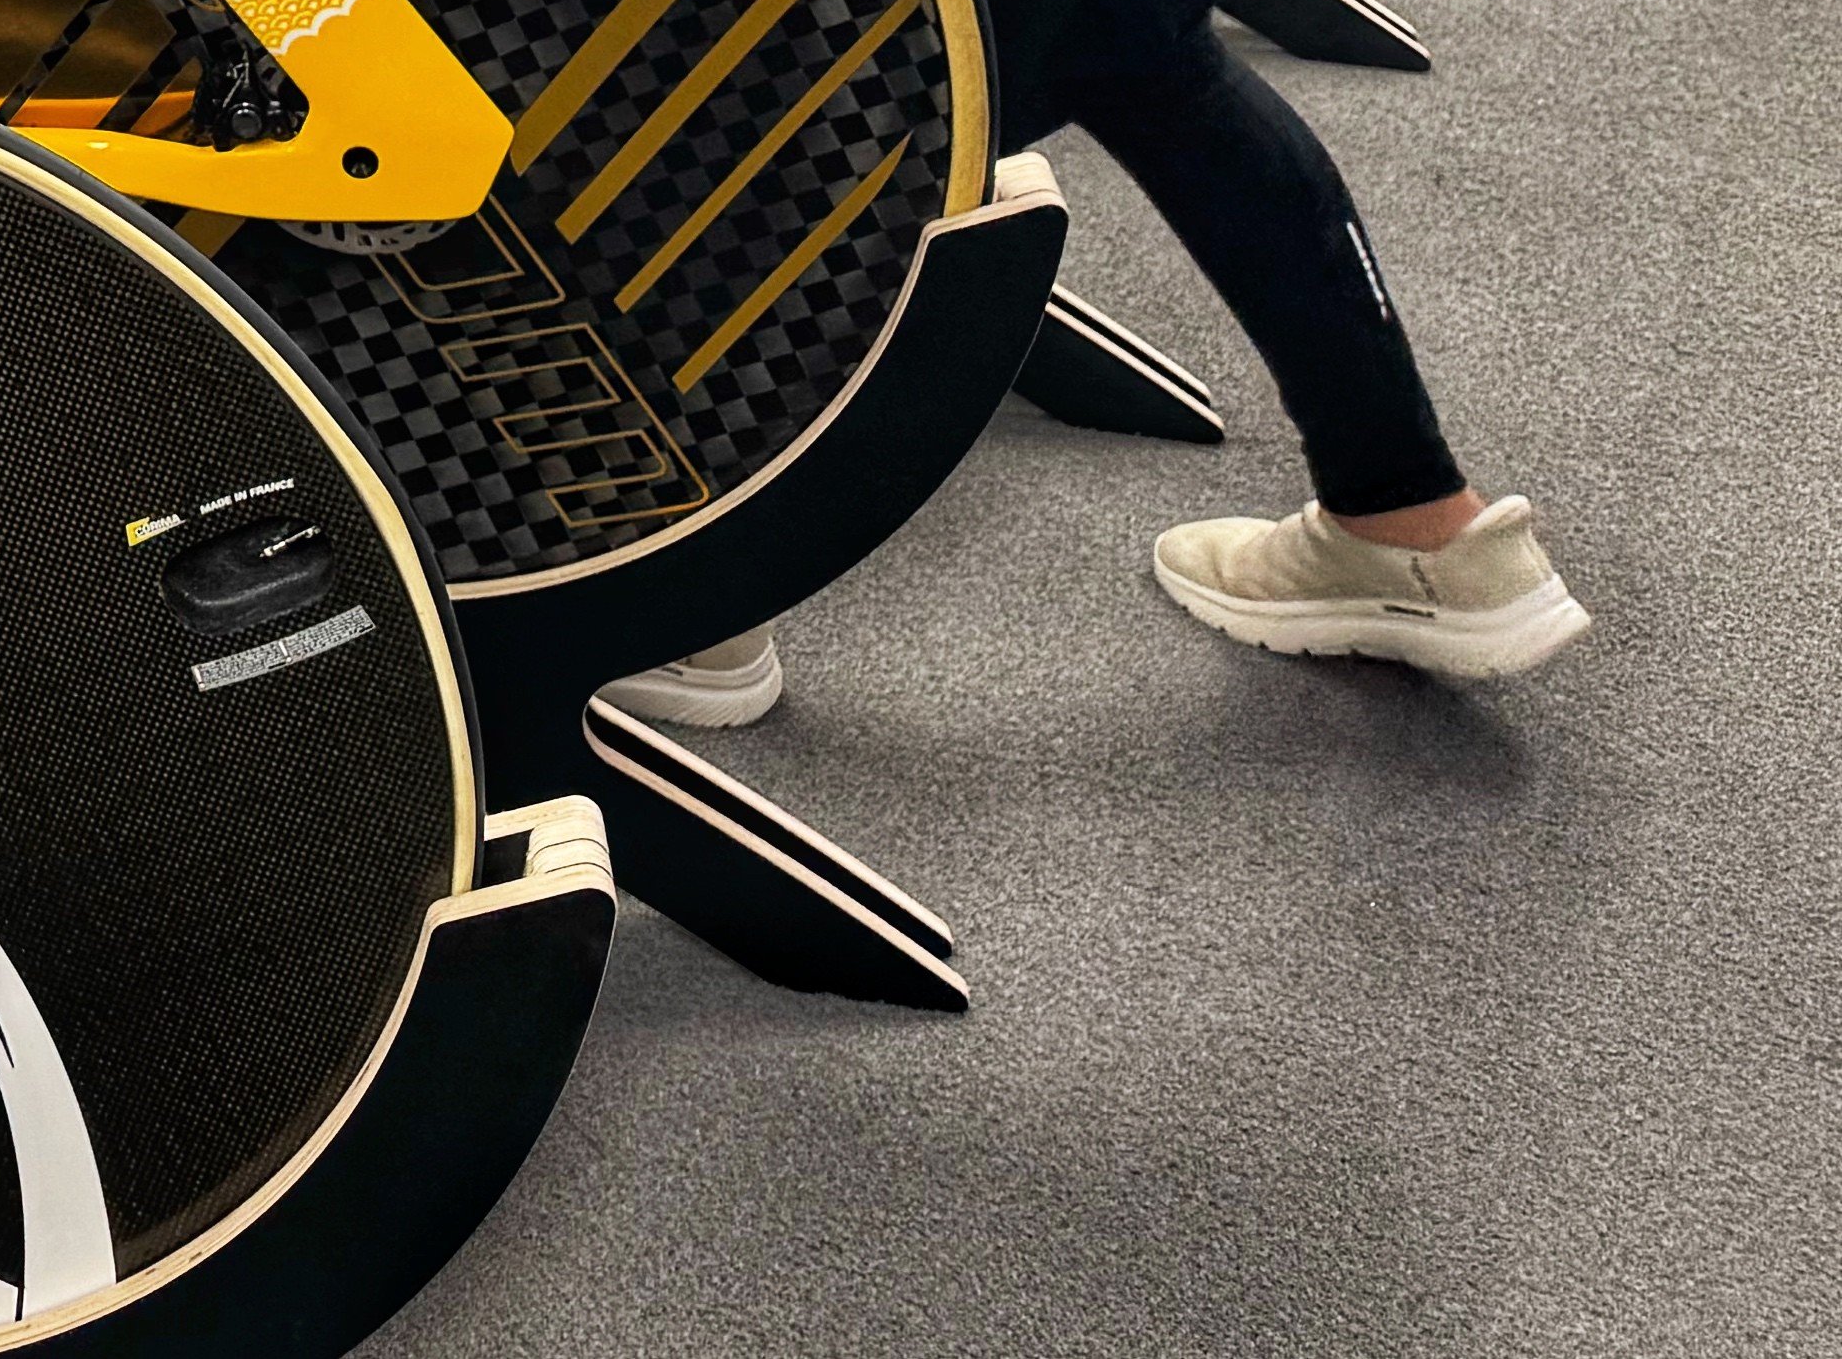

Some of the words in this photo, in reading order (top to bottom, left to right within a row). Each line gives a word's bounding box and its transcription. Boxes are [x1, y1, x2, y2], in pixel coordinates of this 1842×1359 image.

[199, 495, 233, 515] MADE
[233, 488, 249, 502] IN
[249, 478, 295, 498] FRANCE
[133, 513, 182, 538] CORIMA
